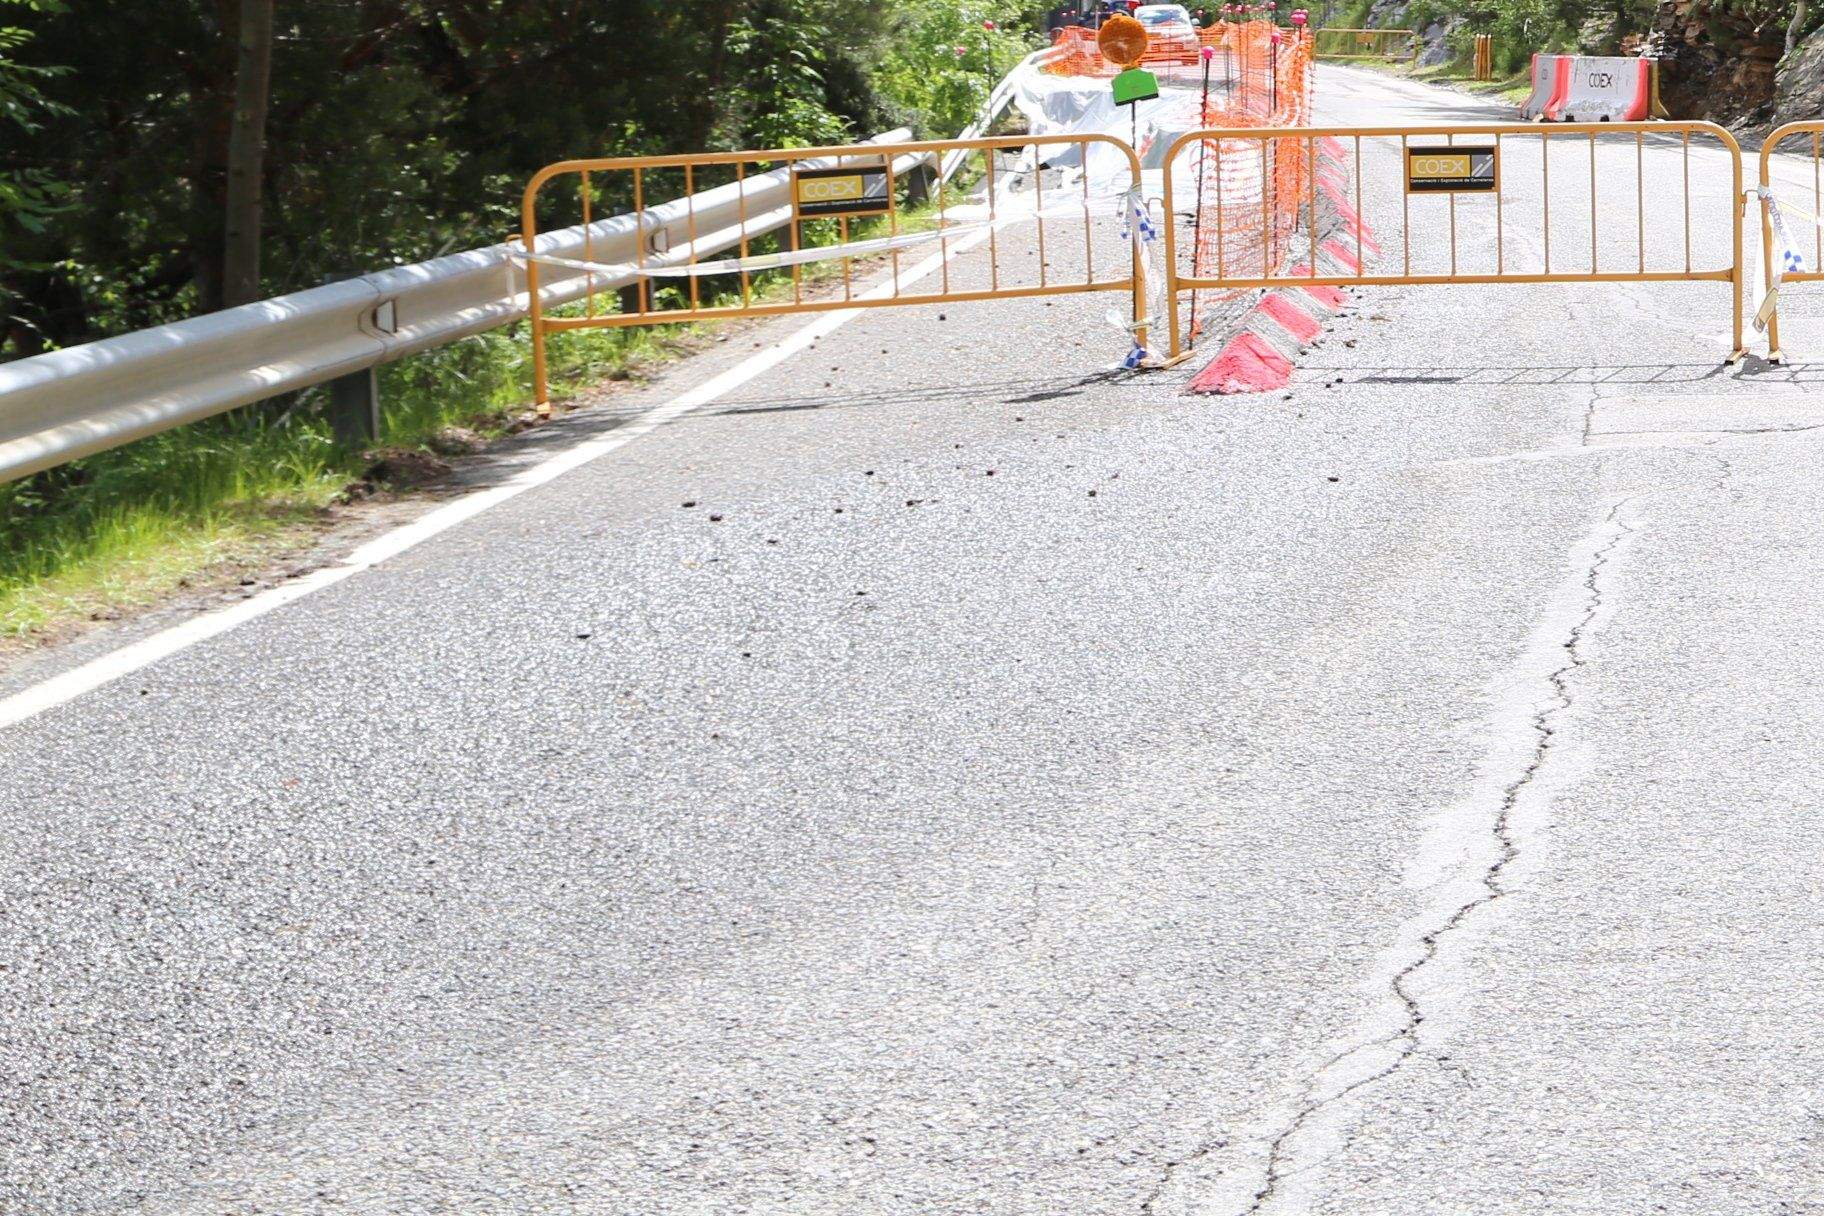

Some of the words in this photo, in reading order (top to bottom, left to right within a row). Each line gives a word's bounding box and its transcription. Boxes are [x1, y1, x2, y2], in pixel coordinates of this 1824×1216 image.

[1588, 72, 1614, 88] COEX
[1415, 159, 1464, 174] COEX
[804, 181, 856, 197] COEX
